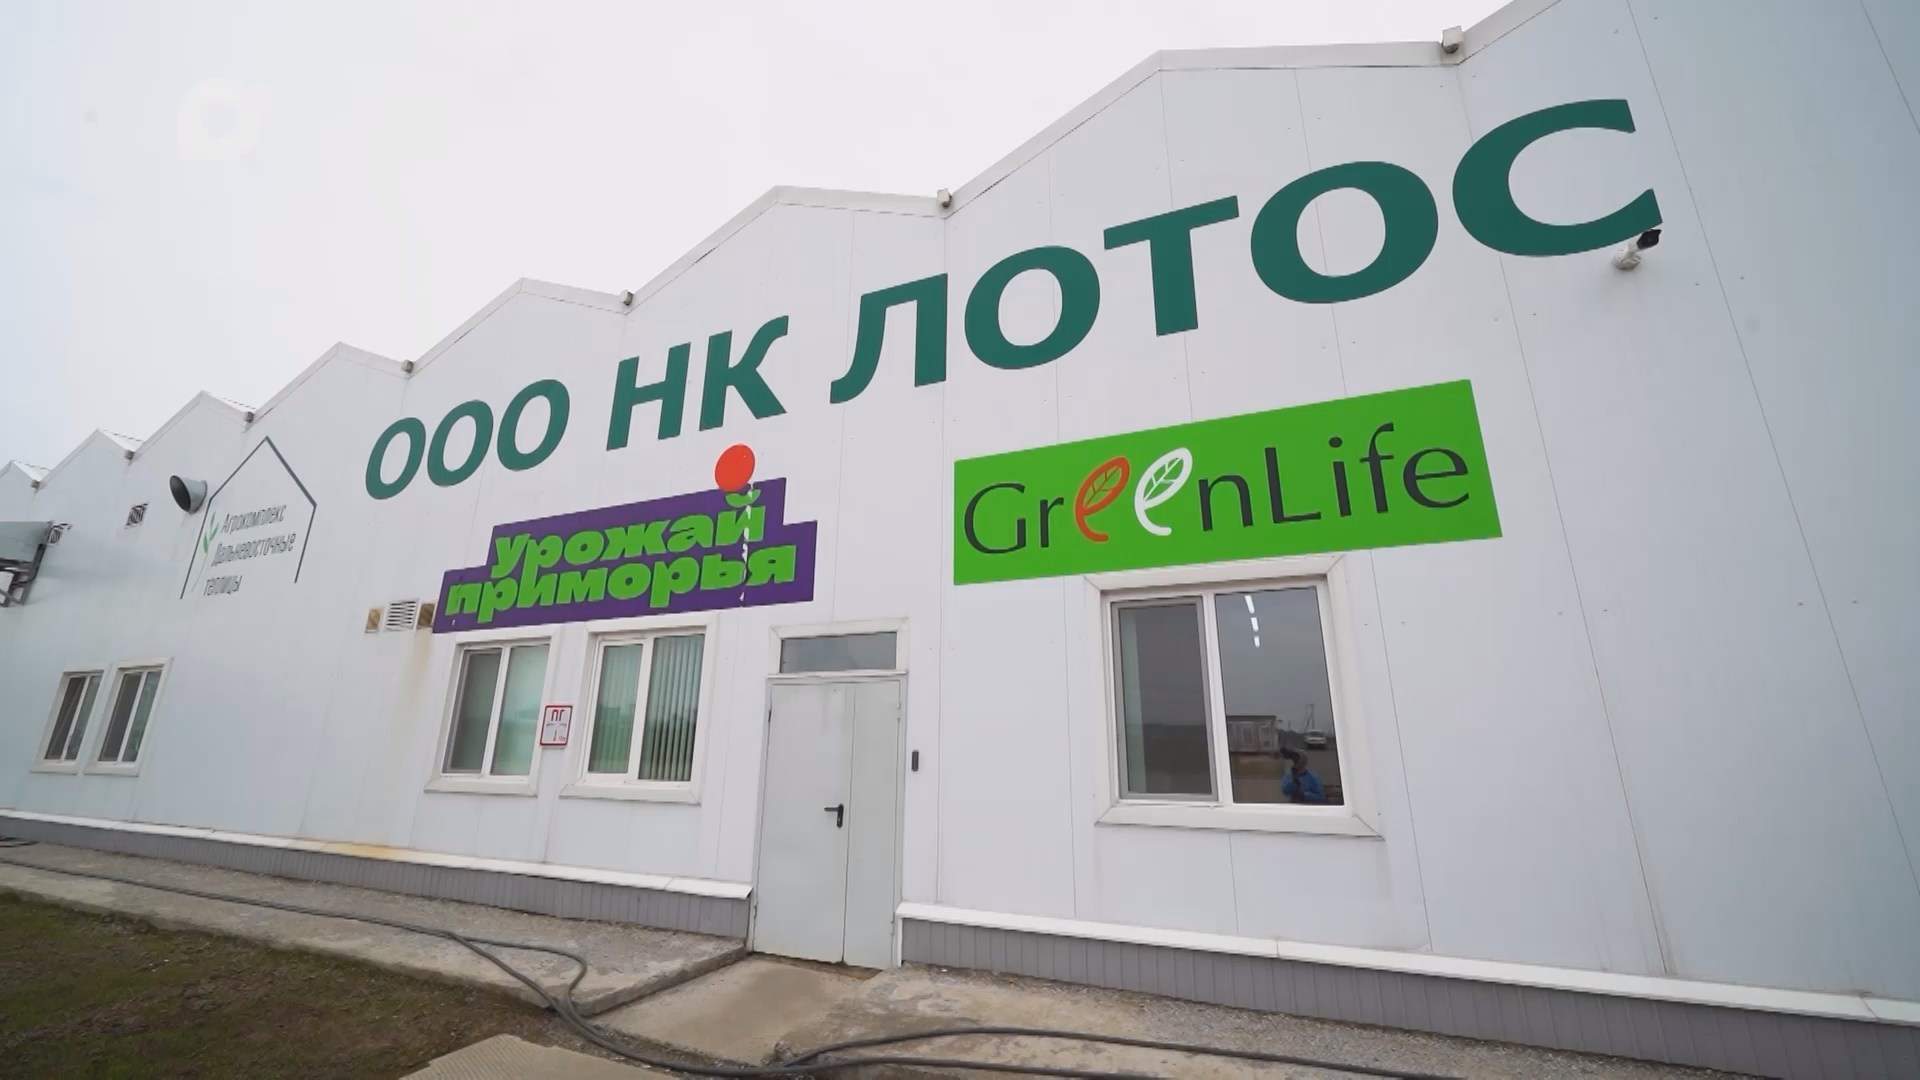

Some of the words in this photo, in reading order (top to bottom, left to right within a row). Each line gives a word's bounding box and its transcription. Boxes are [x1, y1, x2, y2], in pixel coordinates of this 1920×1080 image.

[367, 380, 569, 498] ООО
[608, 317, 789, 450] НК
[830, 99, 1660, 402] ЛОТОС
[963, 421, 1471, 555] GreenLife
